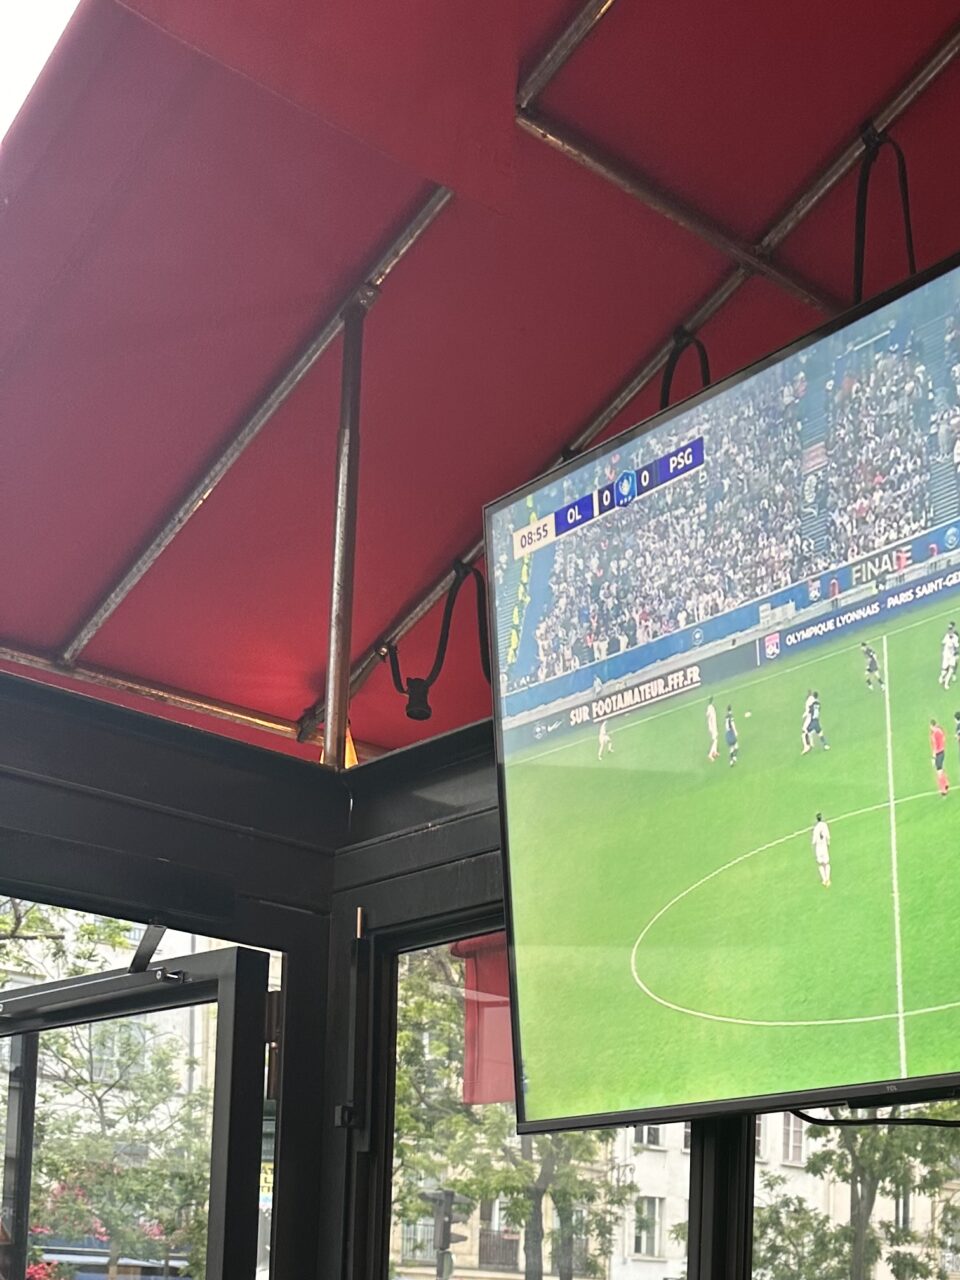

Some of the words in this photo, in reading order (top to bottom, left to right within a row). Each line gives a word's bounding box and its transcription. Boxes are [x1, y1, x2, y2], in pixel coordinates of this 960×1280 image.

[520, 524, 548, 549] 08:55
[566, 508, 582, 524] OL
[602, 491, 611, 506] 0
[641, 470, 650, 487] 0
[669, 448, 693, 473] PSG
[786, 619, 835, 646] OLYMPIQUE
[836, 602, 880, 627] LYONNAIS
[887, 589, 914, 608] PARIS
[570, 705, 590, 726] SUR
